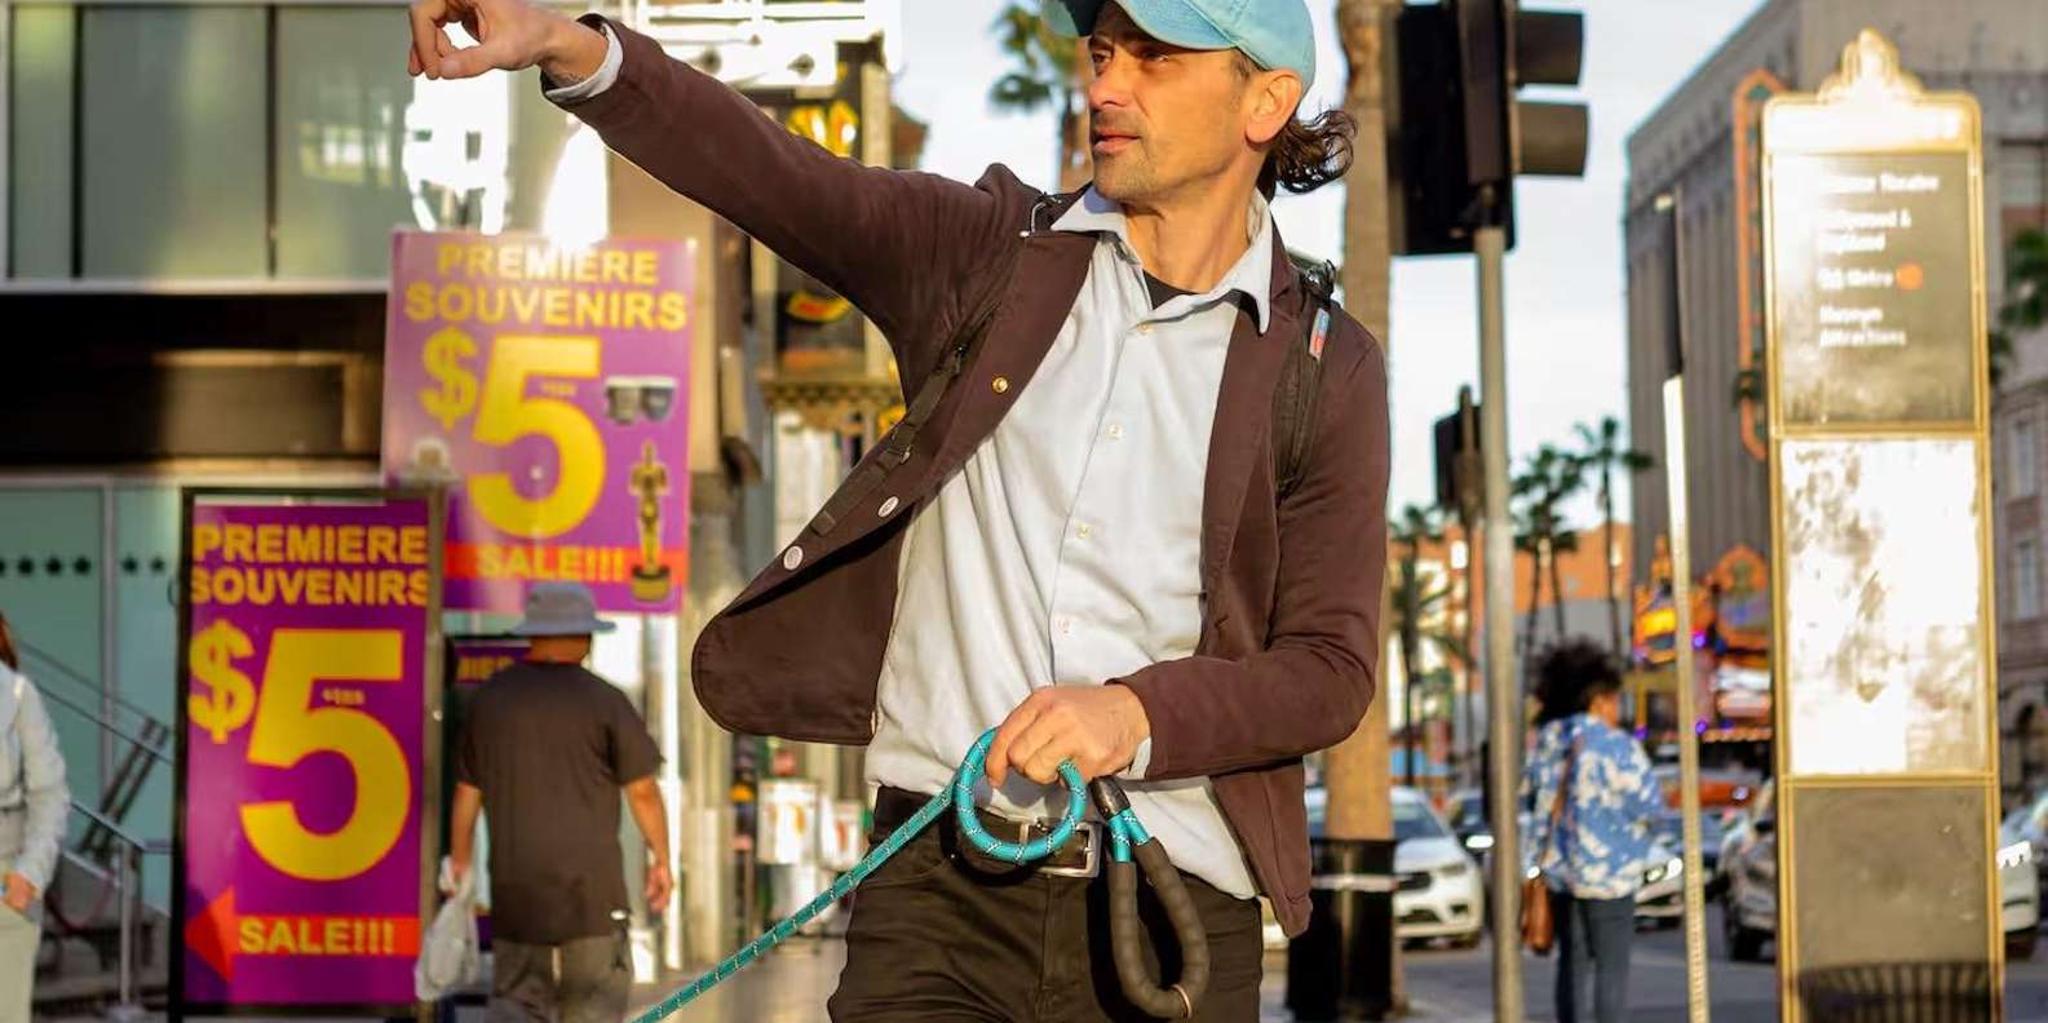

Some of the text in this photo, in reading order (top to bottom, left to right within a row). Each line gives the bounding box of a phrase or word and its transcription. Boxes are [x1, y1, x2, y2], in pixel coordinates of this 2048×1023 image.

[438, 244, 658, 285] PREMIERE
[405, 282, 686, 331] SOUVENIRS
[193, 524, 427, 563] PREMIERE
[478, 546, 626, 579] SALE!!!
[191, 567, 427, 605] SOUVENIRS
[239, 918, 394, 954] SALE!!!
